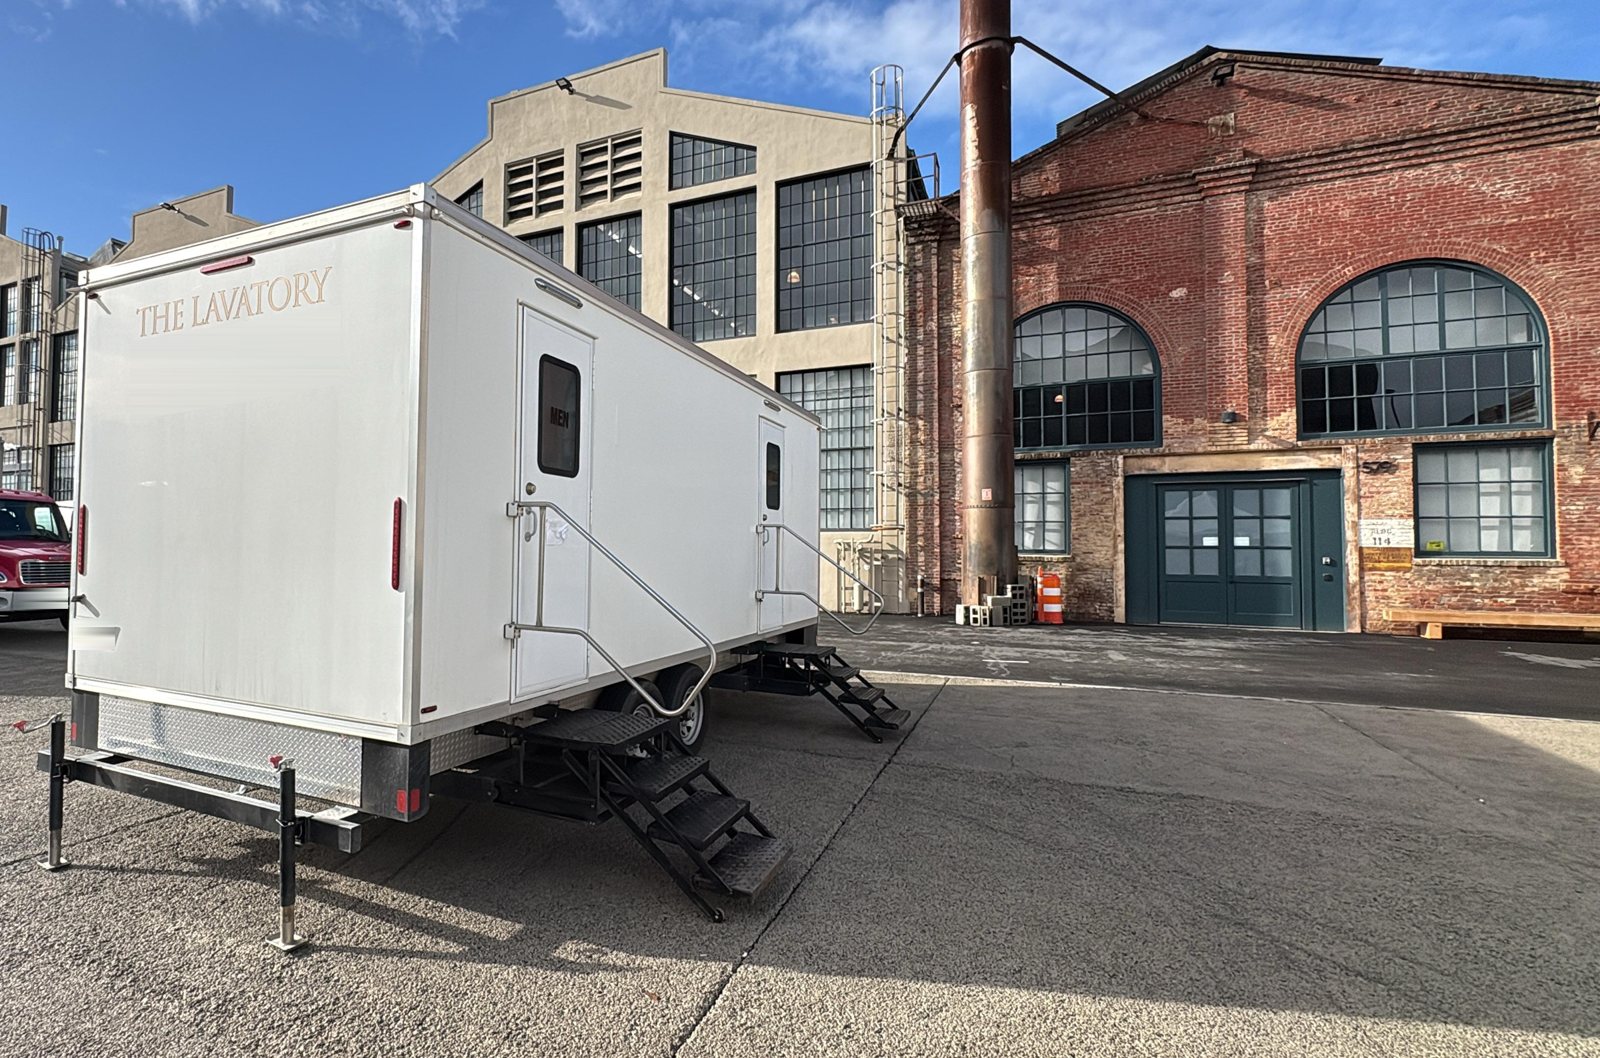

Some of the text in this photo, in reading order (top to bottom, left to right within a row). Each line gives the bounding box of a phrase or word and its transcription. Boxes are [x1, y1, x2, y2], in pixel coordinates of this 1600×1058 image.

[136, 266, 333, 338] THE LAVATORY
[550, 406, 569, 429] MEN
[1372, 537, 1392, 546] 114
